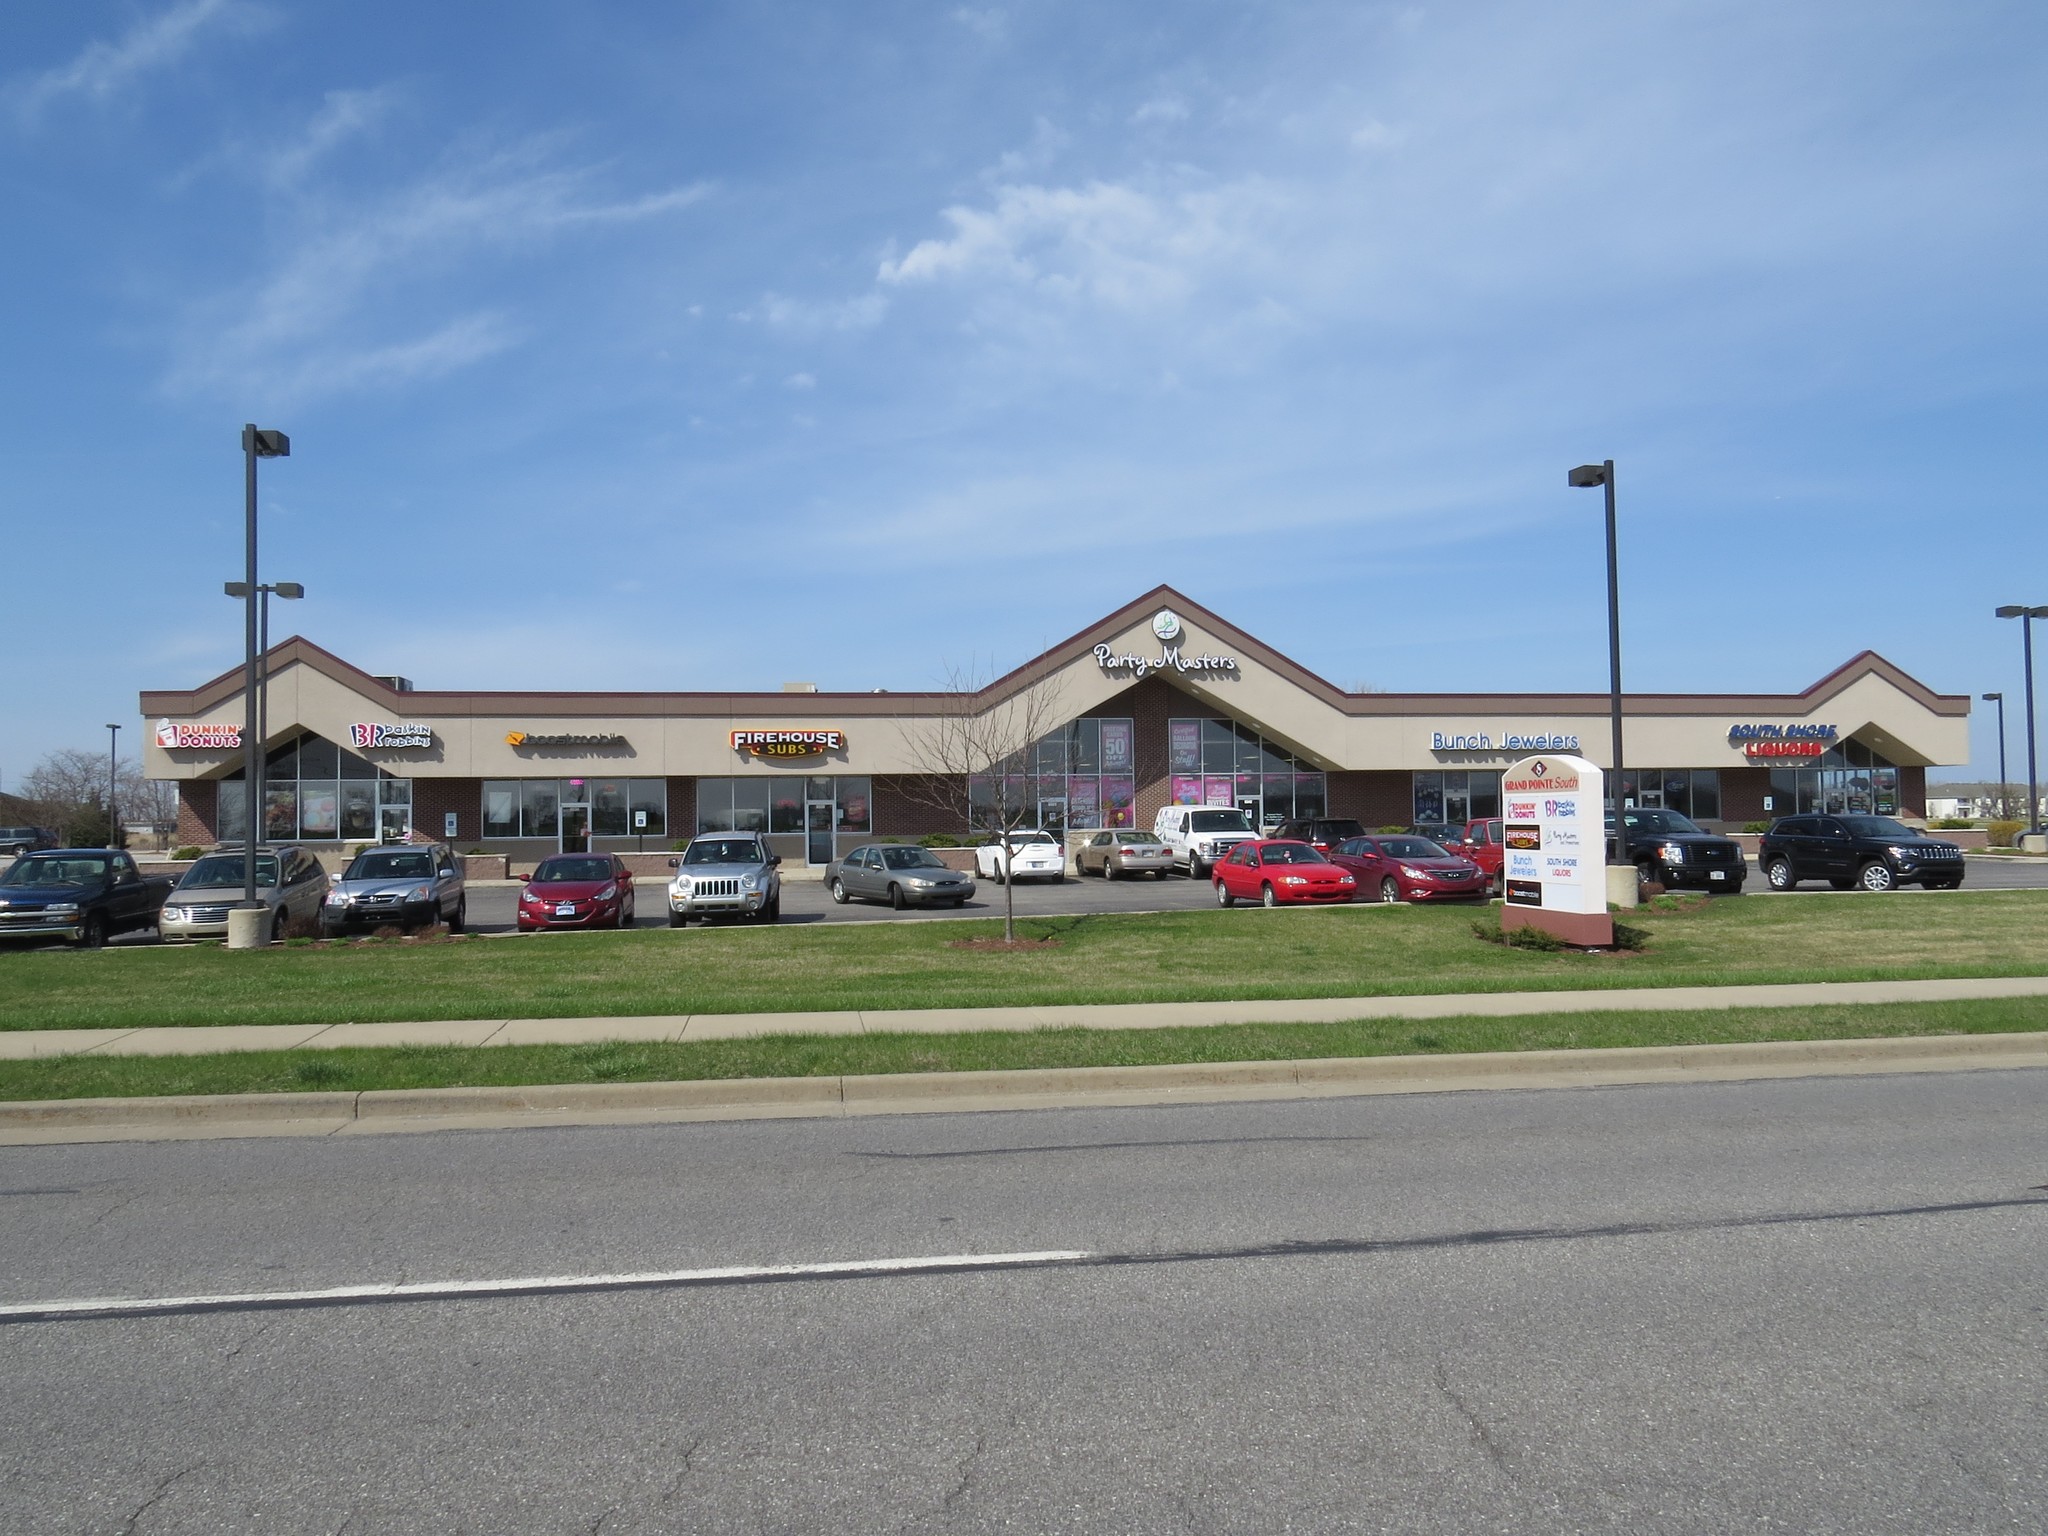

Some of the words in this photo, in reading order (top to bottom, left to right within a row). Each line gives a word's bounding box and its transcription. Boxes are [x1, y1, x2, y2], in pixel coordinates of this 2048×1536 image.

[1093, 642, 1148, 677] Party
[1153, 645, 1236, 673] Masters
[180, 724, 243, 736] DUNKIN'
[384, 724, 431, 736] baskin
[1727, 724, 1782, 738] SOUTH
[1783, 724, 1838, 738] SHORE
[179, 735, 242, 748] DONUTS
[384, 736, 431, 748] robbins
[733, 732, 840, 751] FIREHOUSE
[1105, 738, 1126, 755] 50
[1431, 732, 1491, 750] Bunch
[1498, 732, 1579, 750] Jewelers
[766, 744, 806, 755] SUBS
[1743, 742, 1823, 757] LIQUORS
[1505, 780, 1528, 790] GRAND
[1529, 778, 1554, 789] POINTE
[1555, 776, 1578, 789] South
[1514, 811, 1536, 819] DONUTS
[1507, 831, 1539, 842] FIREHOUSE
[1513, 855, 1533, 866] Bunch
[1546, 857, 1562, 866] SOUTH
[1562, 858, 1578, 867] SHORE
[1510, 866, 1538, 877] Jewelers
[1552, 869, 1571, 877] LIQUORS
